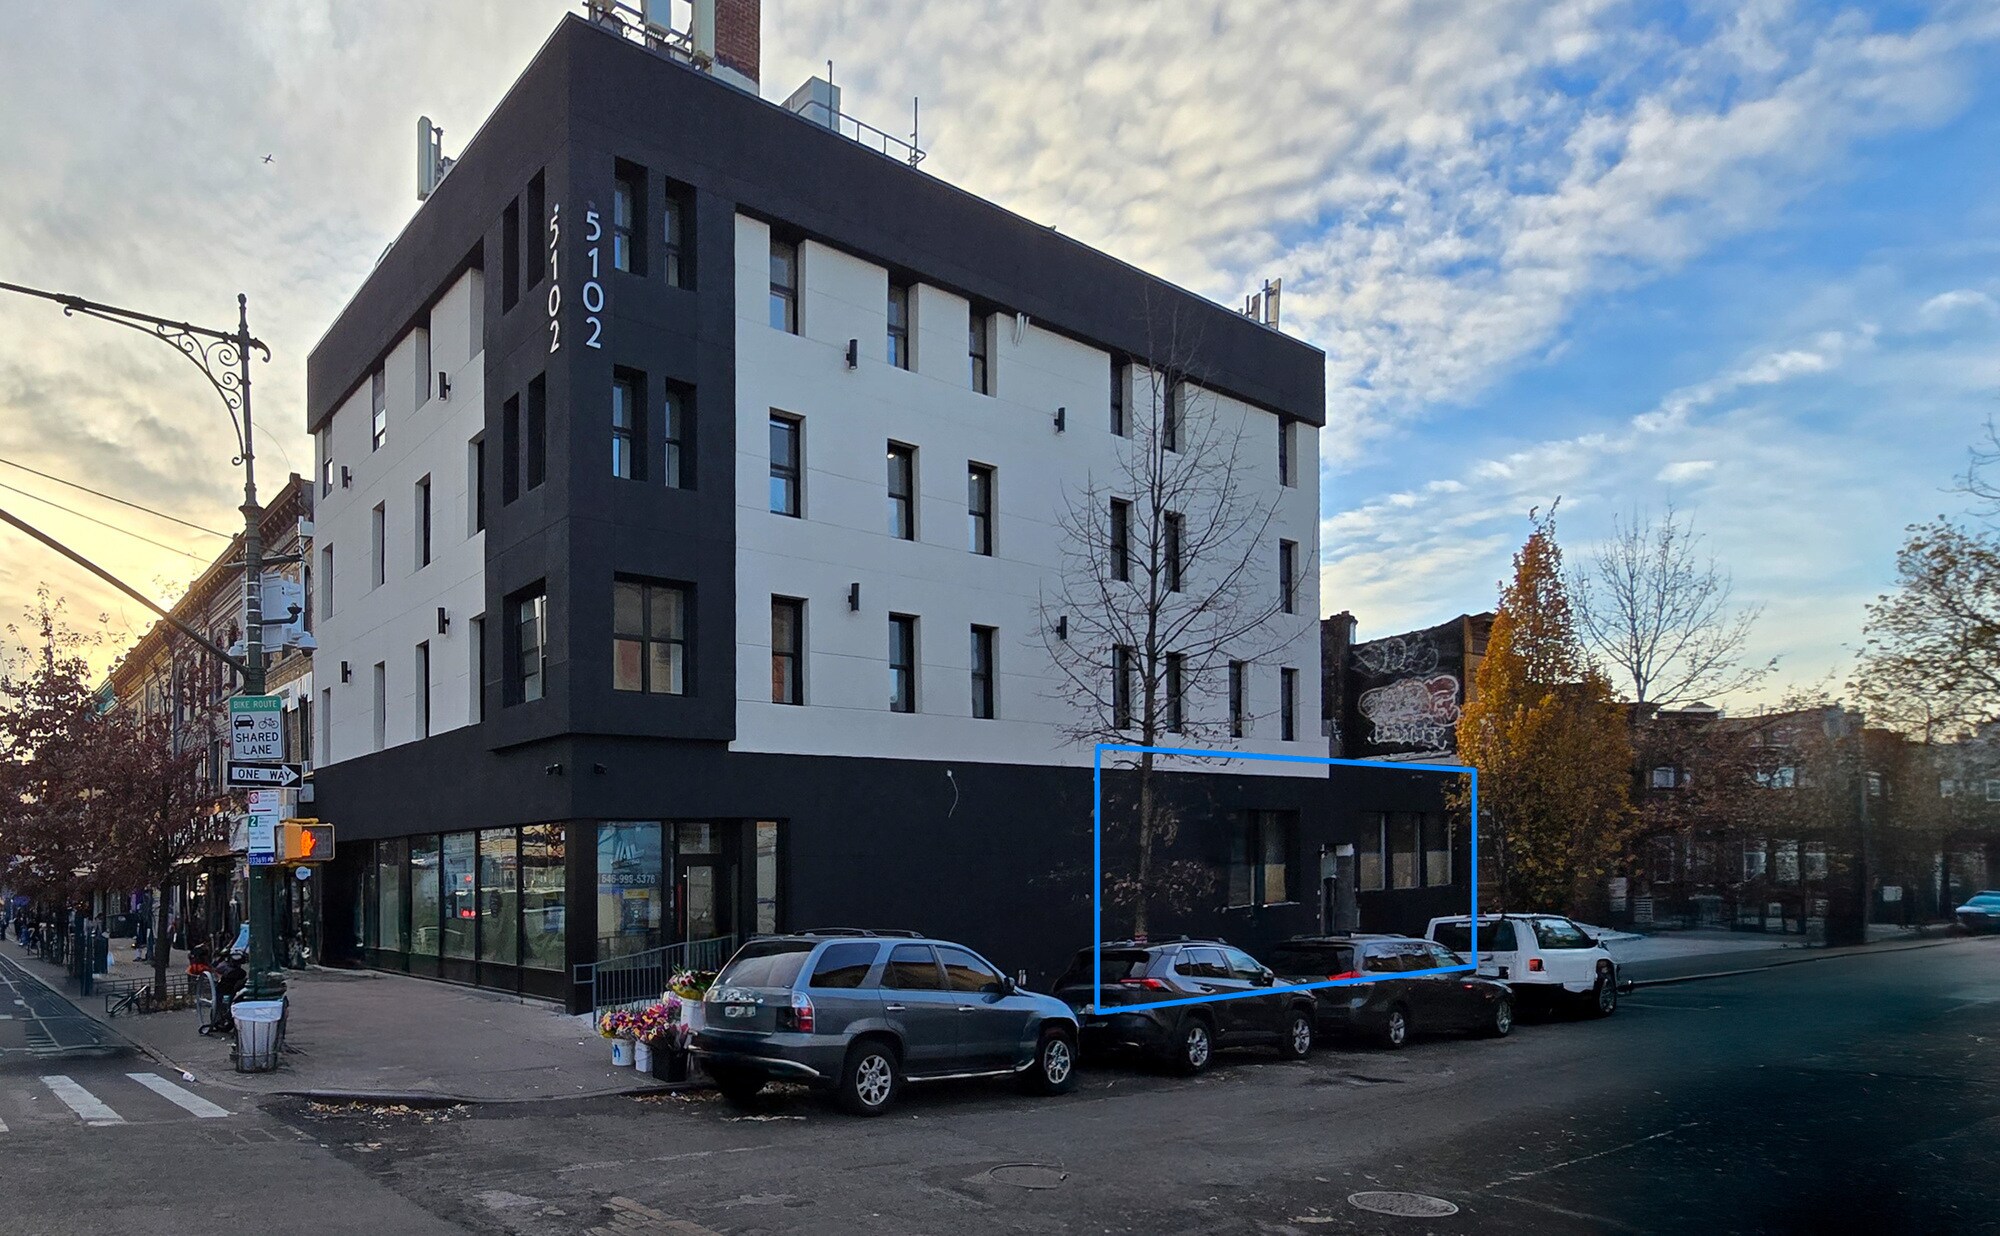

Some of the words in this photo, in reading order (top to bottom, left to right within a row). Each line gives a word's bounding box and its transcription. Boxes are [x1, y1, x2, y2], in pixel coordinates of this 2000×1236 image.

[548, 214, 561, 354] 5102
[582, 210, 605, 349] 5102
[233, 701, 250, 709] BIKE
[253, 700, 277, 708] ROUTE
[235, 731, 279, 743] SHARED
[243, 745, 272, 755] LANE
[238, 769, 260, 779] ONE
[269, 770, 292, 781] WAY
